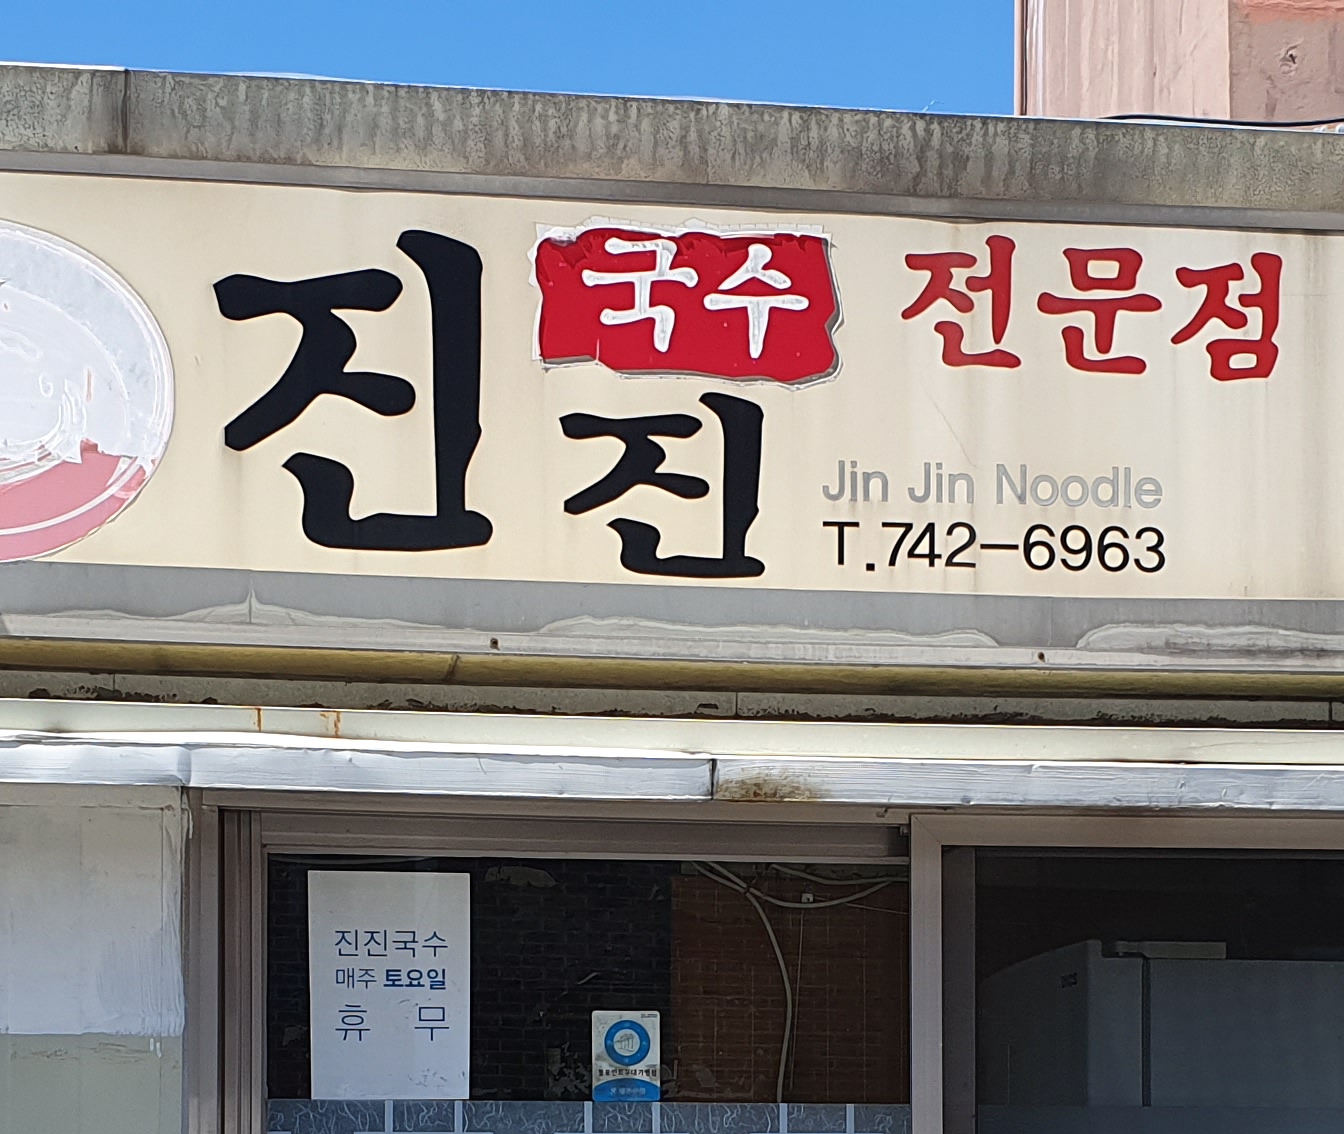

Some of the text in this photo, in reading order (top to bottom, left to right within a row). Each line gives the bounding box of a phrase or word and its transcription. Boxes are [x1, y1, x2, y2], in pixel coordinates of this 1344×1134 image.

[580, 234, 1283, 382] 국수 전문점
[213, 229, 766, 578] 진 진
[822, 459, 1163, 509] Jin Jin Noodle
[822, 521, 1166, 573] T.742-6963
[335, 929, 448, 958] 진진국수
[335, 967, 446, 990] 매주 토요일
